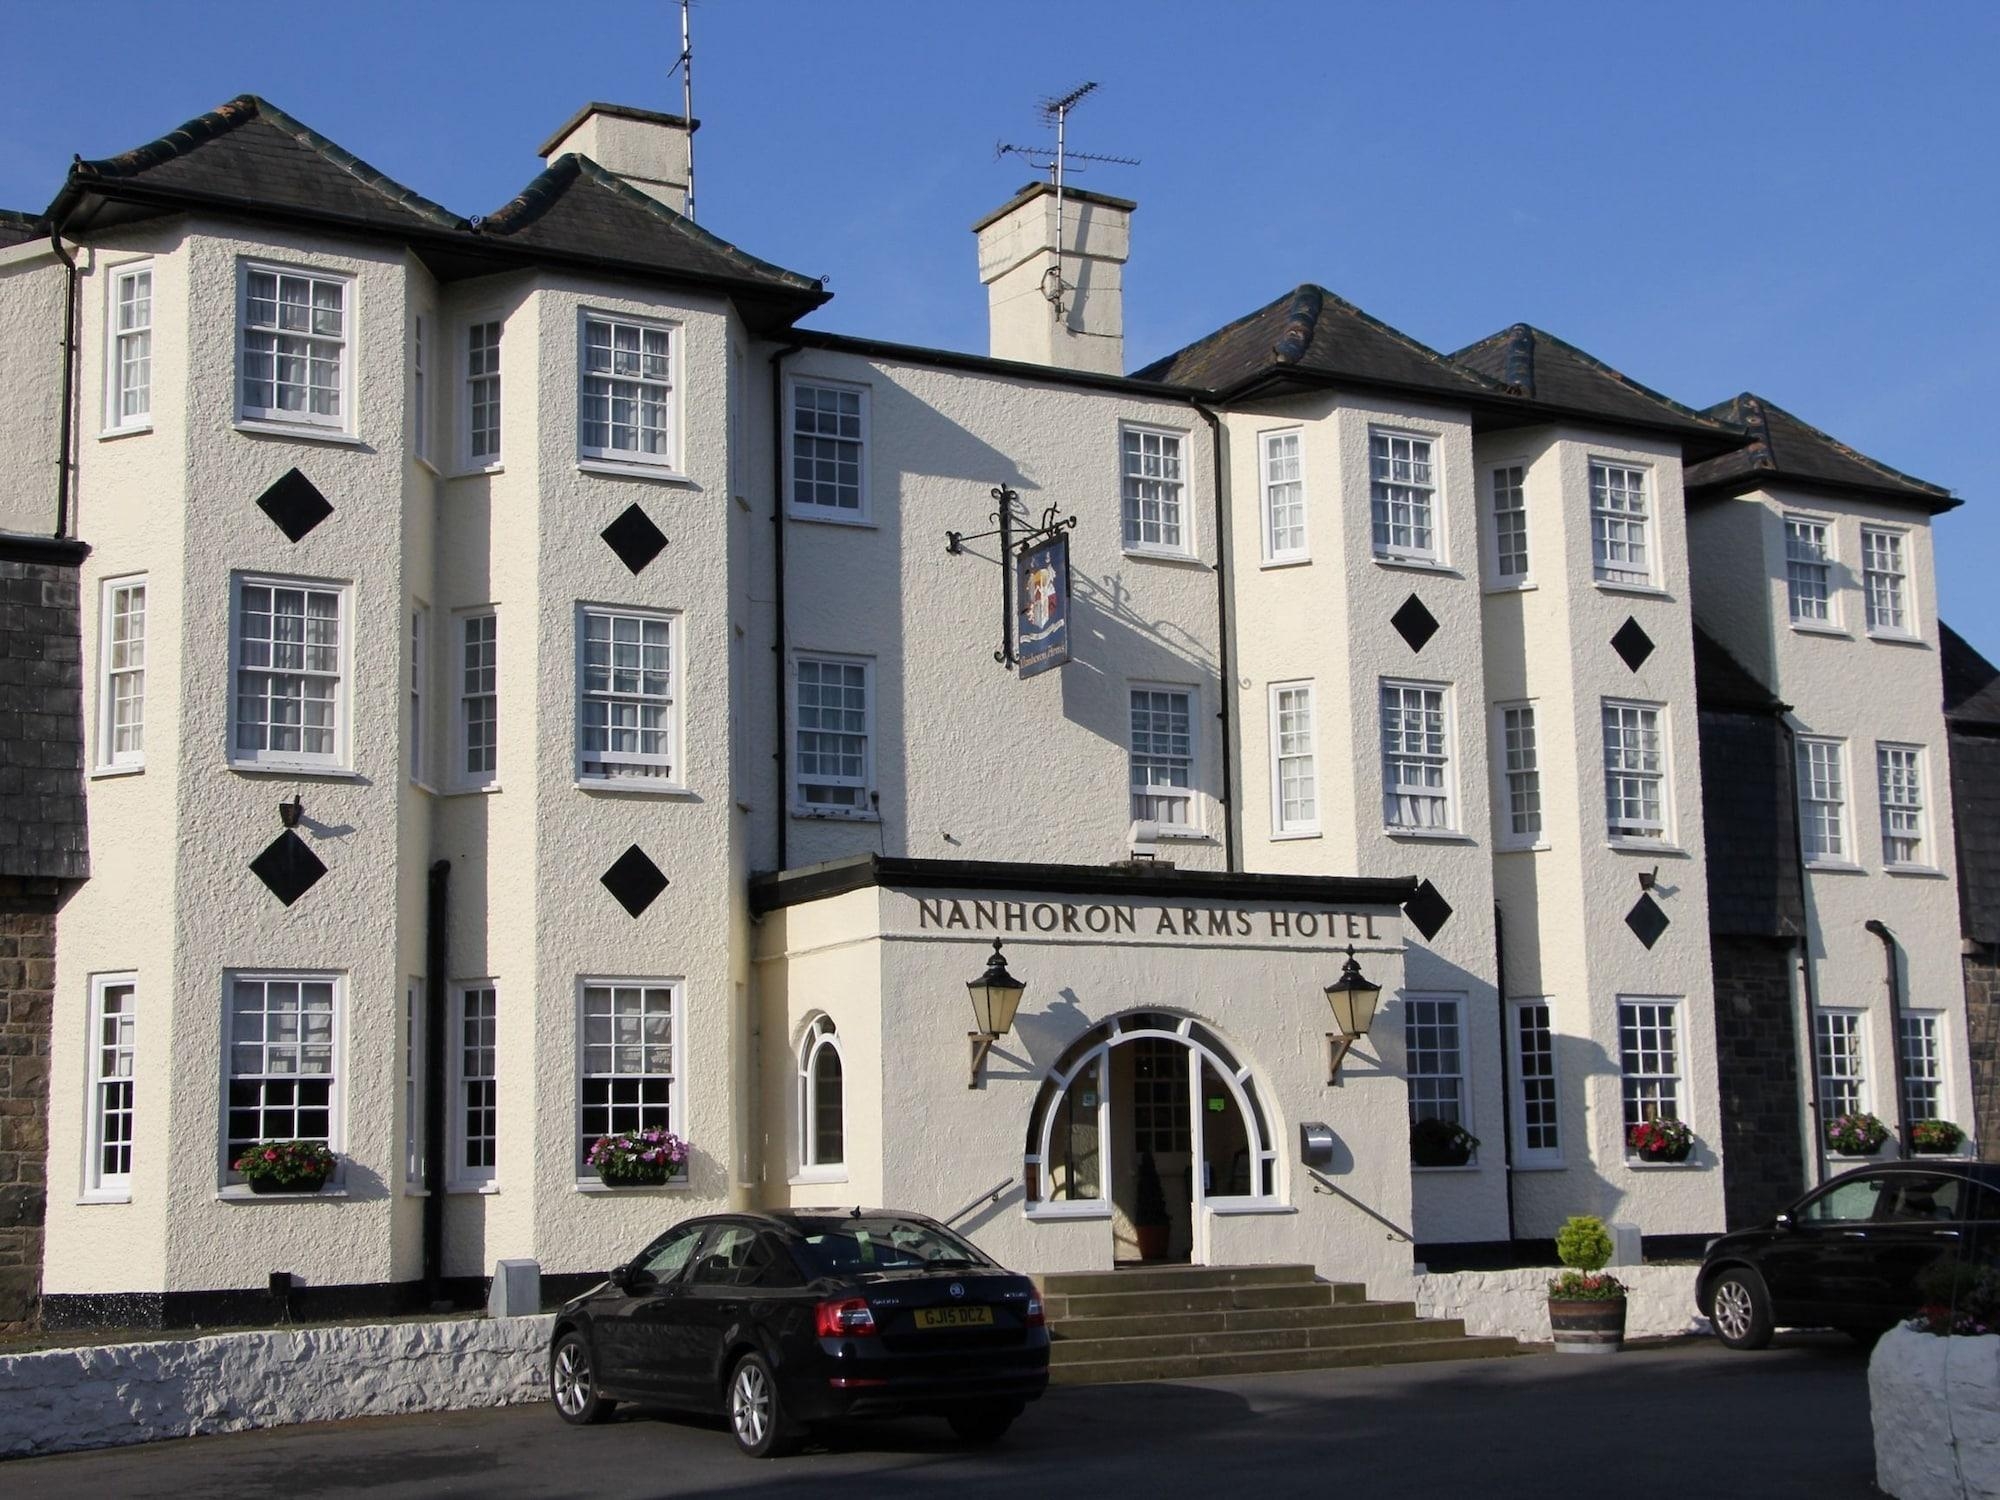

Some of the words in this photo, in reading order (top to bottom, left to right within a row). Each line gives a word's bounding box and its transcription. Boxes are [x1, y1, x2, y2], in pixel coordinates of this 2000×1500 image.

[919, 899, 1136, 933] NANHORON
[1156, 906, 1252, 937] ARMS
[1269, 909, 1382, 940] HOTEL
[925, 1308, 957, 1325] GJ15
[959, 1307, 986, 1323] DCZ
